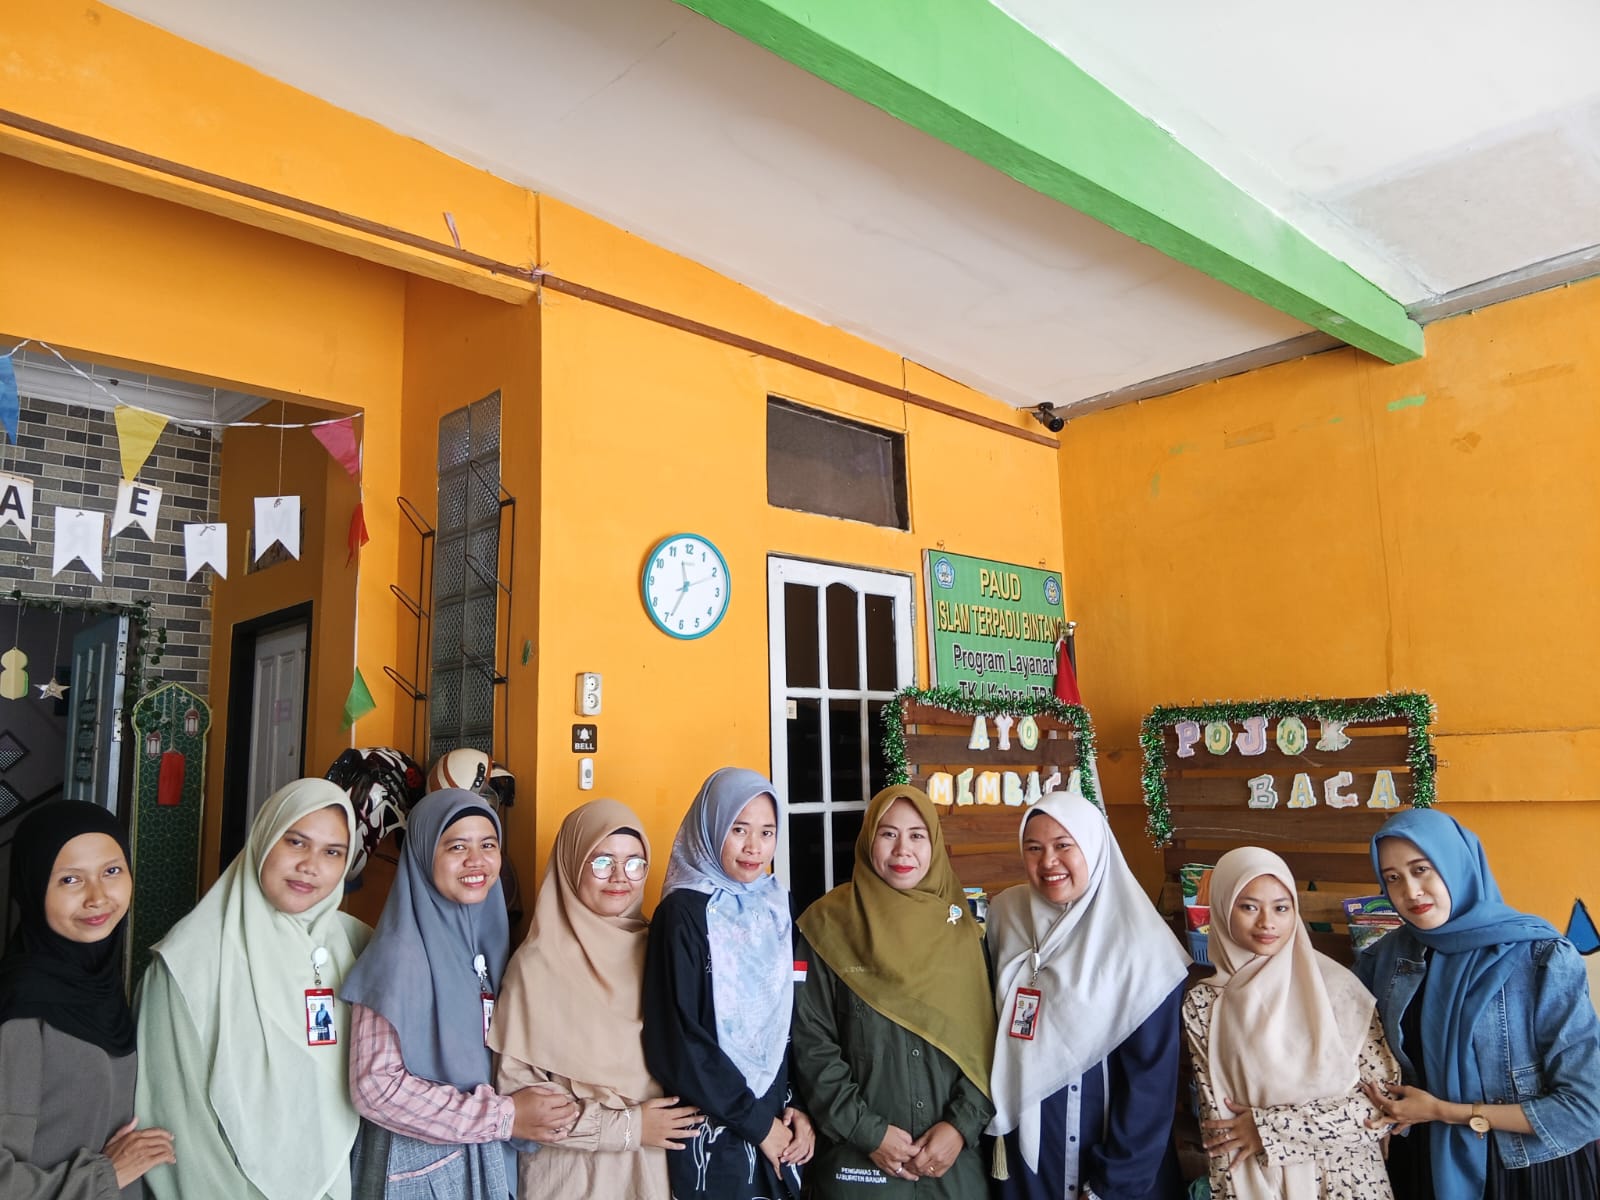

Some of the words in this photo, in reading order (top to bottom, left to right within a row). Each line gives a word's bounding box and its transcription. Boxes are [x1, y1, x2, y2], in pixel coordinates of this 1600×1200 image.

[0, 484, 26, 519] A
[129, 487, 150, 517] E
[669, 545, 677, 558] 11
[685, 544, 694, 555] 12
[702, 551, 706, 562] 1
[656, 558, 664, 569] 10
[712, 567, 717, 577] 2
[649, 576, 655, 586] 9
[979, 568, 1022, 601] PAUD
[715, 587, 720, 598] 3
[652, 597, 658, 607] 8
[707, 606, 712, 617] 4
[664, 612, 669, 623] 7
[694, 617, 700, 628] 5
[936, 600, 970, 634] ISLAM
[972, 605, 1021, 640] TERPADU
[679, 619, 684, 630] 6
[953, 644, 1005, 677] Program
[959, 681, 977, 700] TK
[968, 715, 1039, 751] AYO
[1175, 715, 1352, 758] POJOK
[574, 742, 595, 750] BELL
[1248, 770, 1400, 810] BACA
